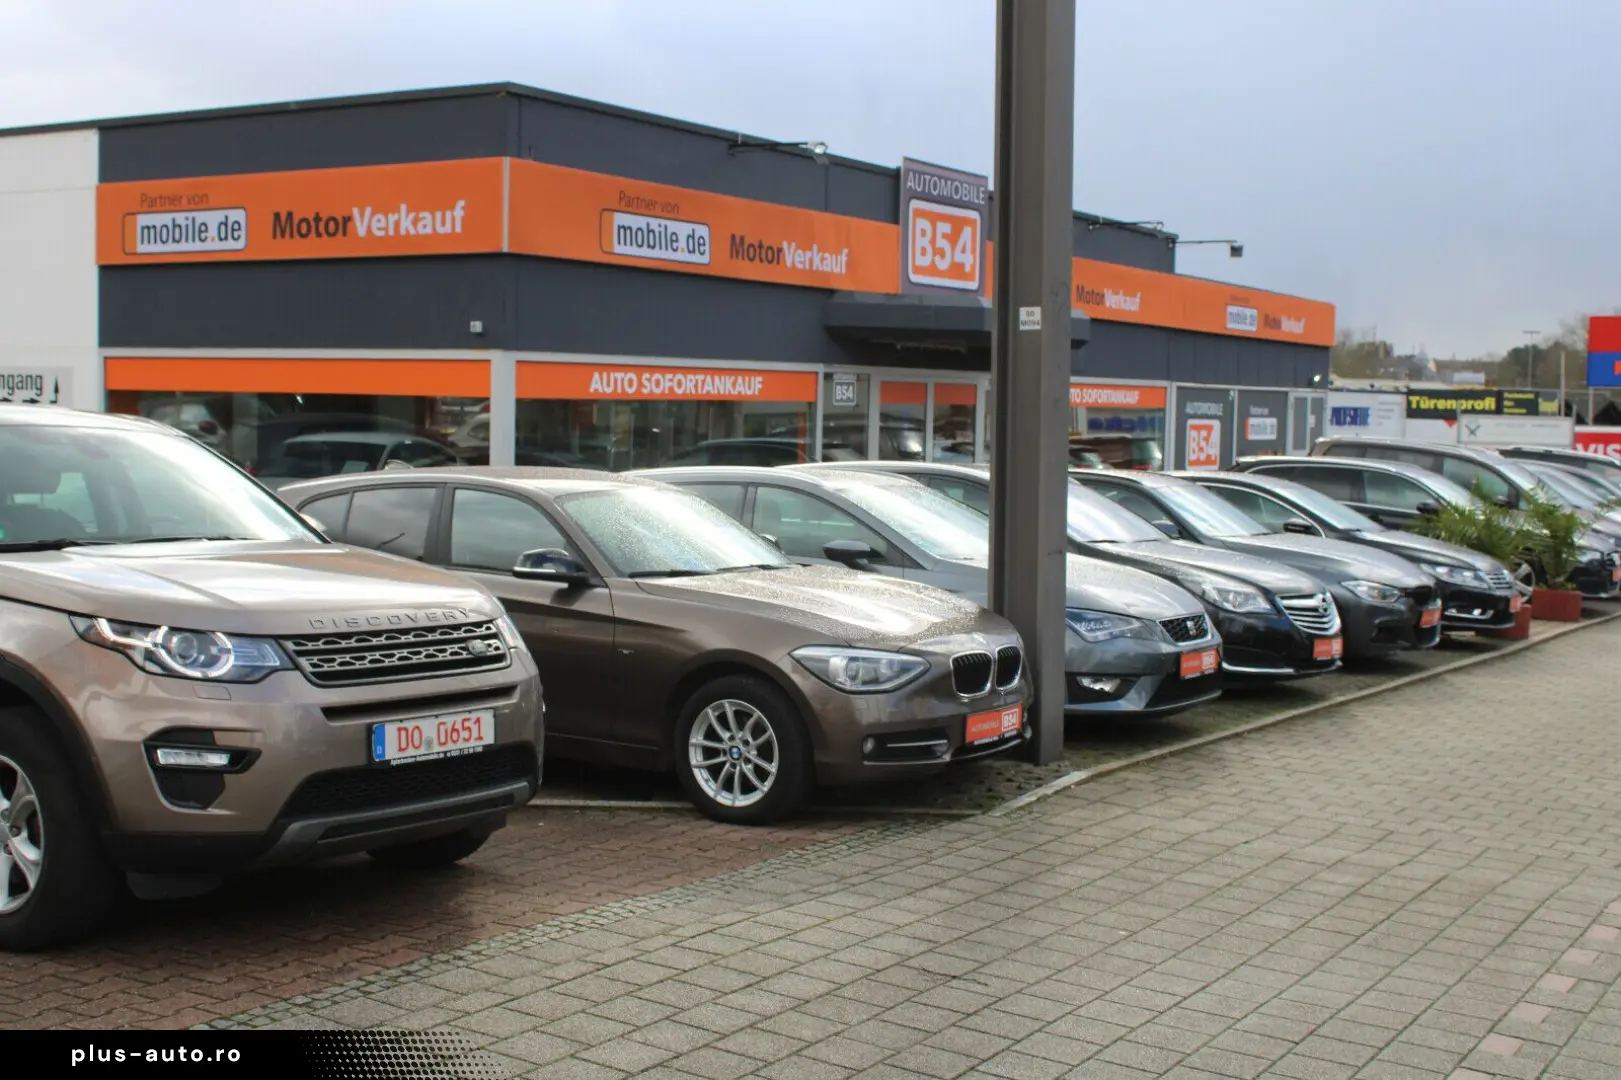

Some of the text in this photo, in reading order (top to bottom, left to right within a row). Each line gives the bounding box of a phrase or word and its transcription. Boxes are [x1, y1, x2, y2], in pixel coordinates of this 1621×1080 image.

[140, 192, 210, 208] Partner von
[618, 190, 680, 215] Partner von
[907, 171, 985, 204] AUTOMOBILE
[139, 215, 242, 246] mobile.de
[271, 199, 465, 240] MotorVerkauf
[616, 221, 707, 256] mobile.de
[729, 233, 849, 274] MotorVerkauf
[914, 217, 974, 273] B54
[590, 371, 763, 396] AUTO SOFORTANKAUF
[835, 385, 854, 400] B54
[1188, 428, 1218, 461] B54
[308, 608, 471, 630] DISCOVERY
[396, 717, 484, 752] DO 0651
